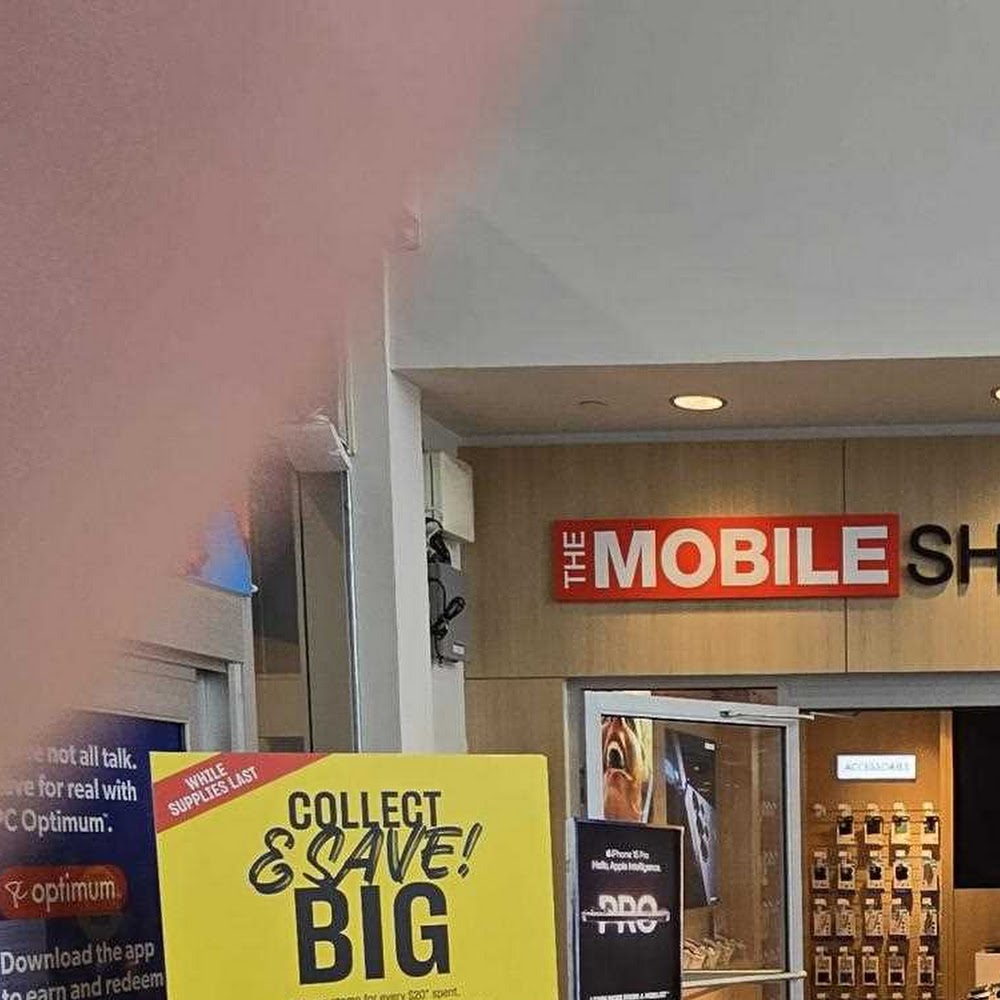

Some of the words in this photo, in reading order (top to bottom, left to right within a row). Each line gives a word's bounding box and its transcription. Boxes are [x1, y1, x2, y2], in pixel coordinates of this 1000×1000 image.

[563, 531, 586, 588] THE
[594, 526, 889, 589] MOBILE
[80, 745, 99, 766] all
[102, 748, 137, 769] talk.
[38, 775, 64, 798] for
[67, 778, 100, 799] real
[101, 779, 138, 801] with
[168, 780, 229, 817] SUPPLIES
[228, 766, 258, 789] LAST
[185, 763, 227, 791] WHILE
[288, 790, 442, 830] COLLECT
[302, 822, 483, 887] SAVE!
[31, 876, 117, 907] optimum
[294, 882, 450, 985] BIG
[1, 945, 93, 976] Download
[96, 944, 122, 964] the
[125, 941, 154, 967] app
[70, 975, 101, 1000] and
[106, 970, 164, 996] redeem
